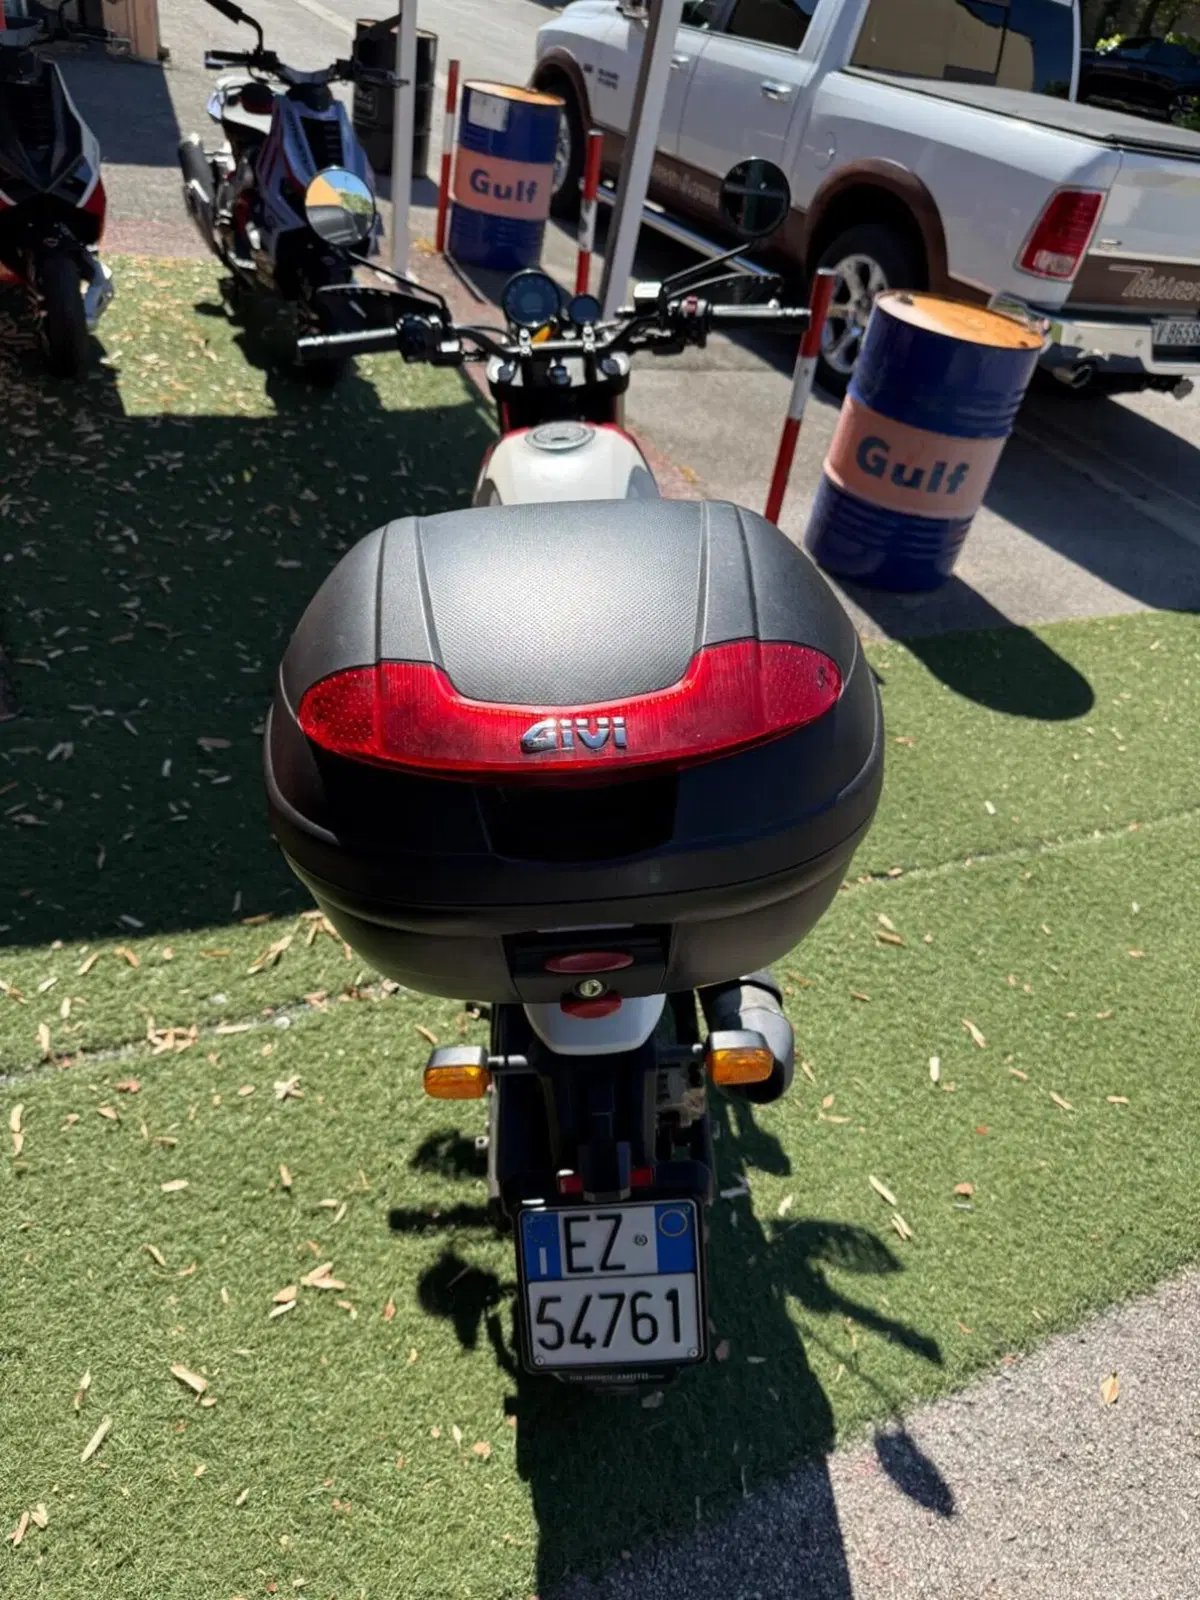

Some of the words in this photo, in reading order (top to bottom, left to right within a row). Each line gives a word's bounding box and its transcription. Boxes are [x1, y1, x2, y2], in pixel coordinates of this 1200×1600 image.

[470, 168, 538, 203] Gulf
[855, 435, 970, 494] Gulf
[520, 716, 627, 753] GIVI
[562, 1213, 626, 1274] EZ
[535, 1288, 681, 1351] 54761
